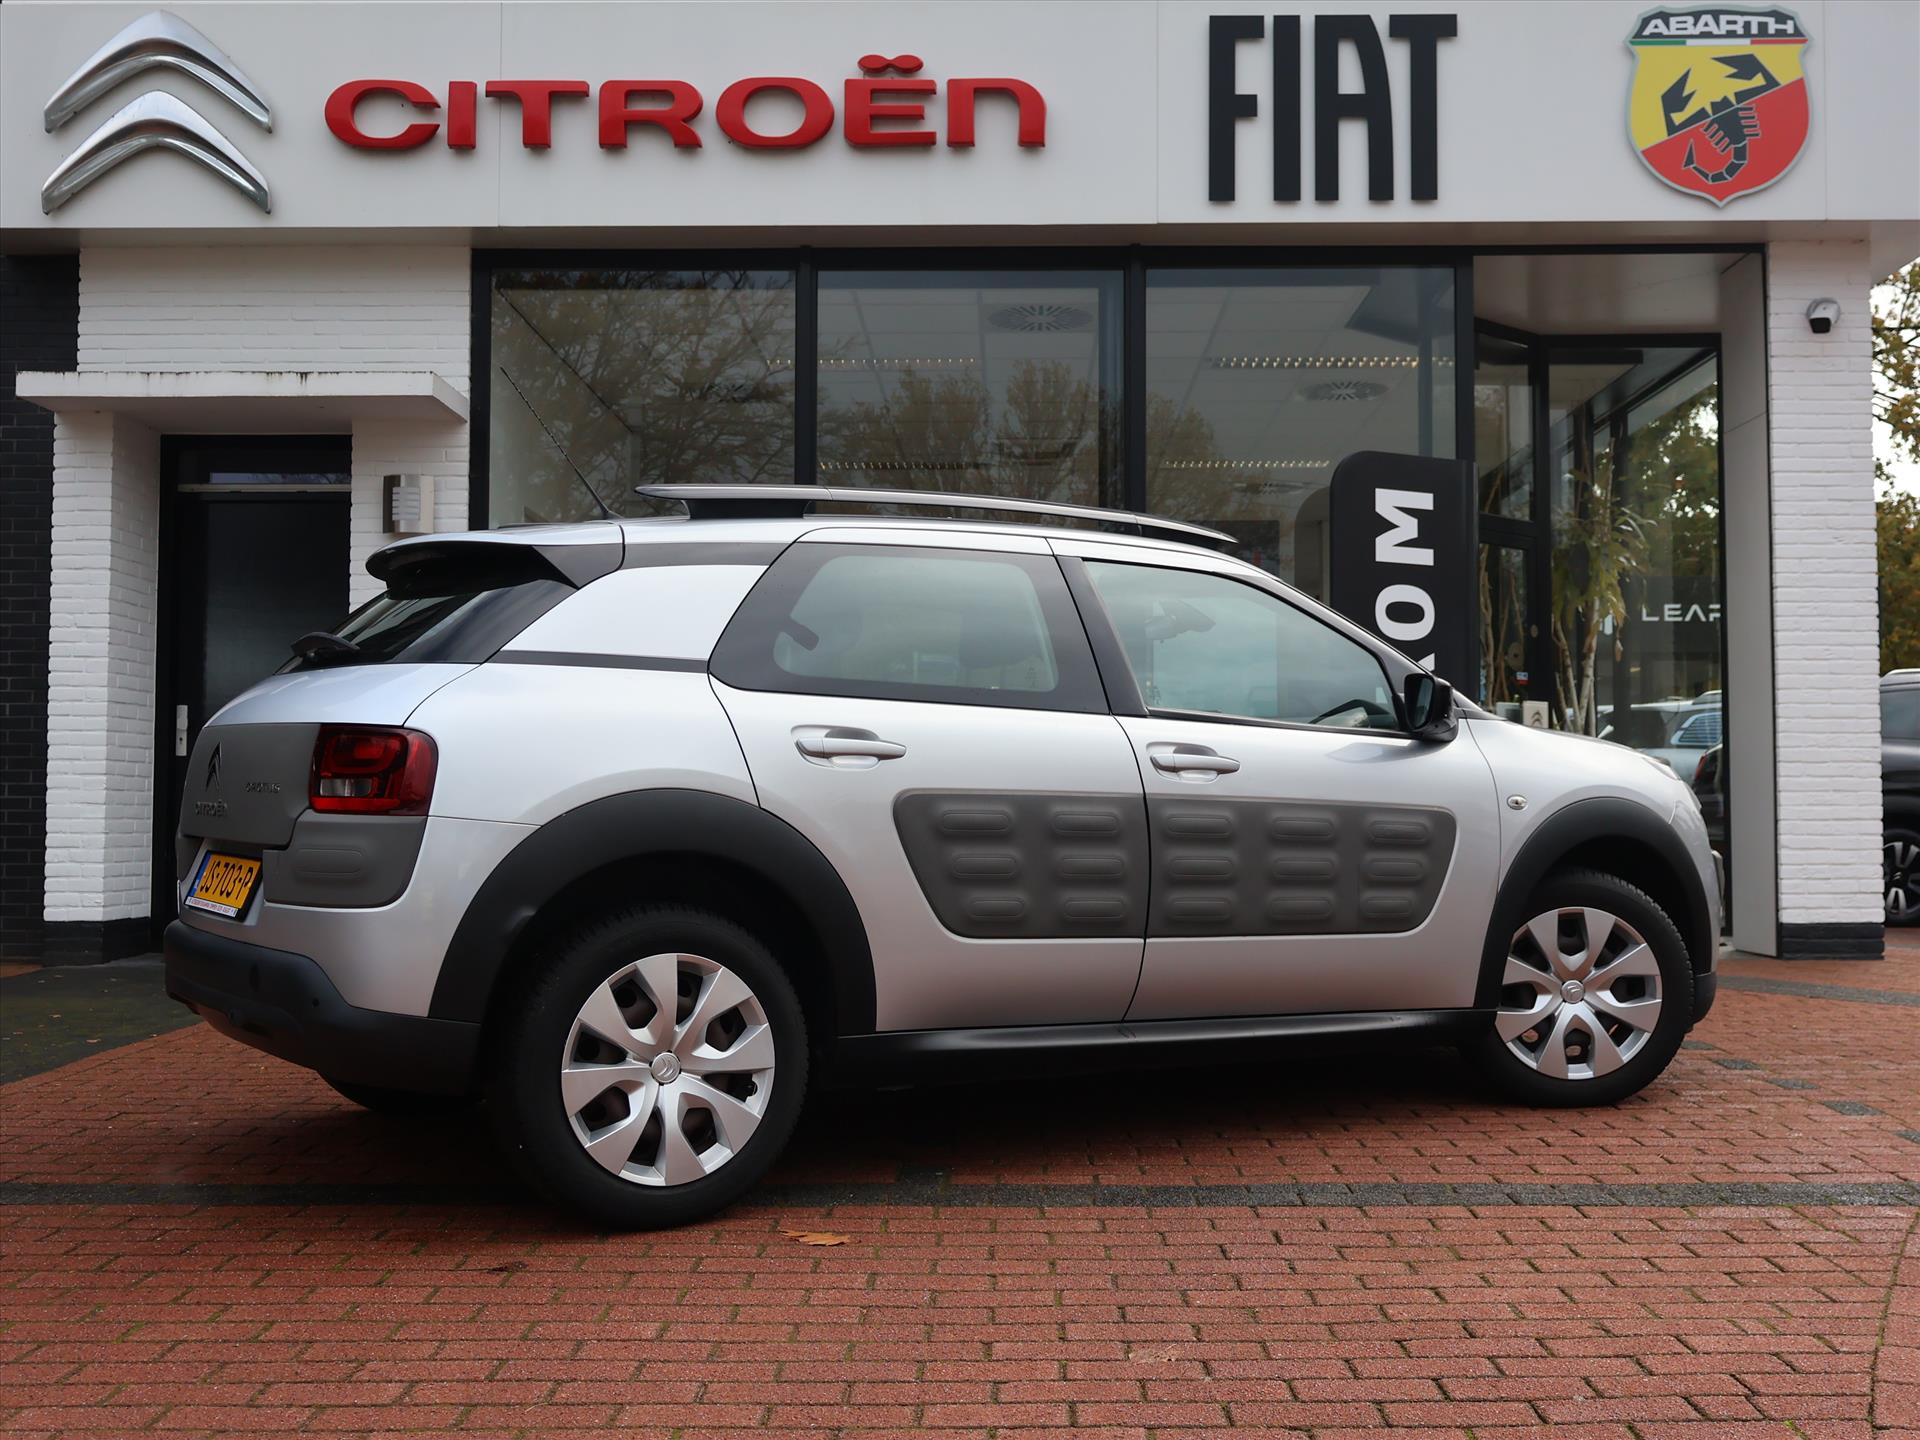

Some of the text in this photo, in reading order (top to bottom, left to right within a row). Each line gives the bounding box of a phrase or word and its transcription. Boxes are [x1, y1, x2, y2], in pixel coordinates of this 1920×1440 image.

[1642, 14, 1794, 36] ABARTH
[1208, 14, 1458, 202] FIAT
[200, 860, 254, 900] JS-703-P
